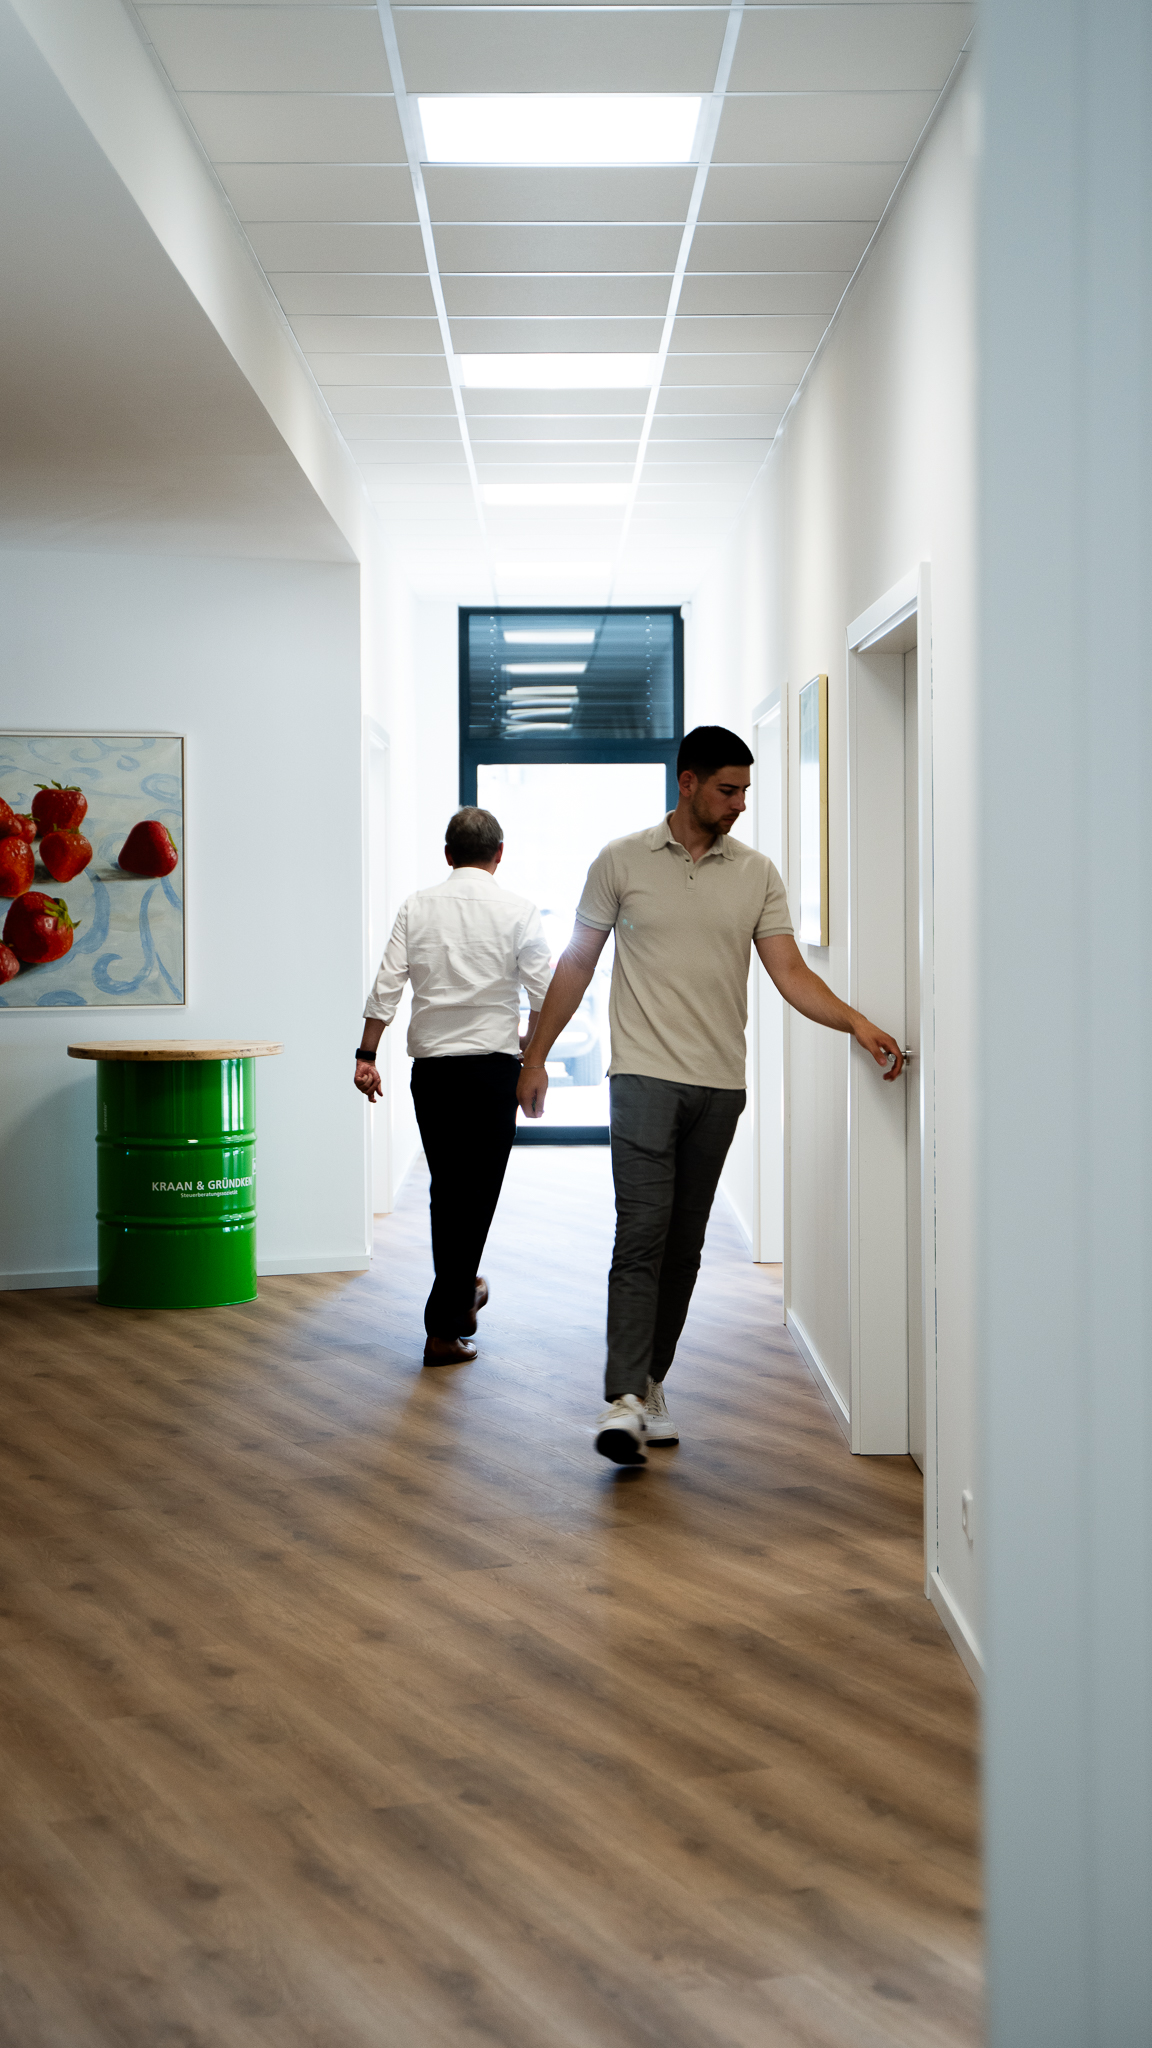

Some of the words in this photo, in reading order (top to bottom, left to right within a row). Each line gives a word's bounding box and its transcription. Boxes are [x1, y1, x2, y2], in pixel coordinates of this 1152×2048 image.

[151, 1181, 193, 1191] KRAAN
[196, 1181, 205, 1191] &
[207, 1176, 253, 1190] GRÜNDKEN
